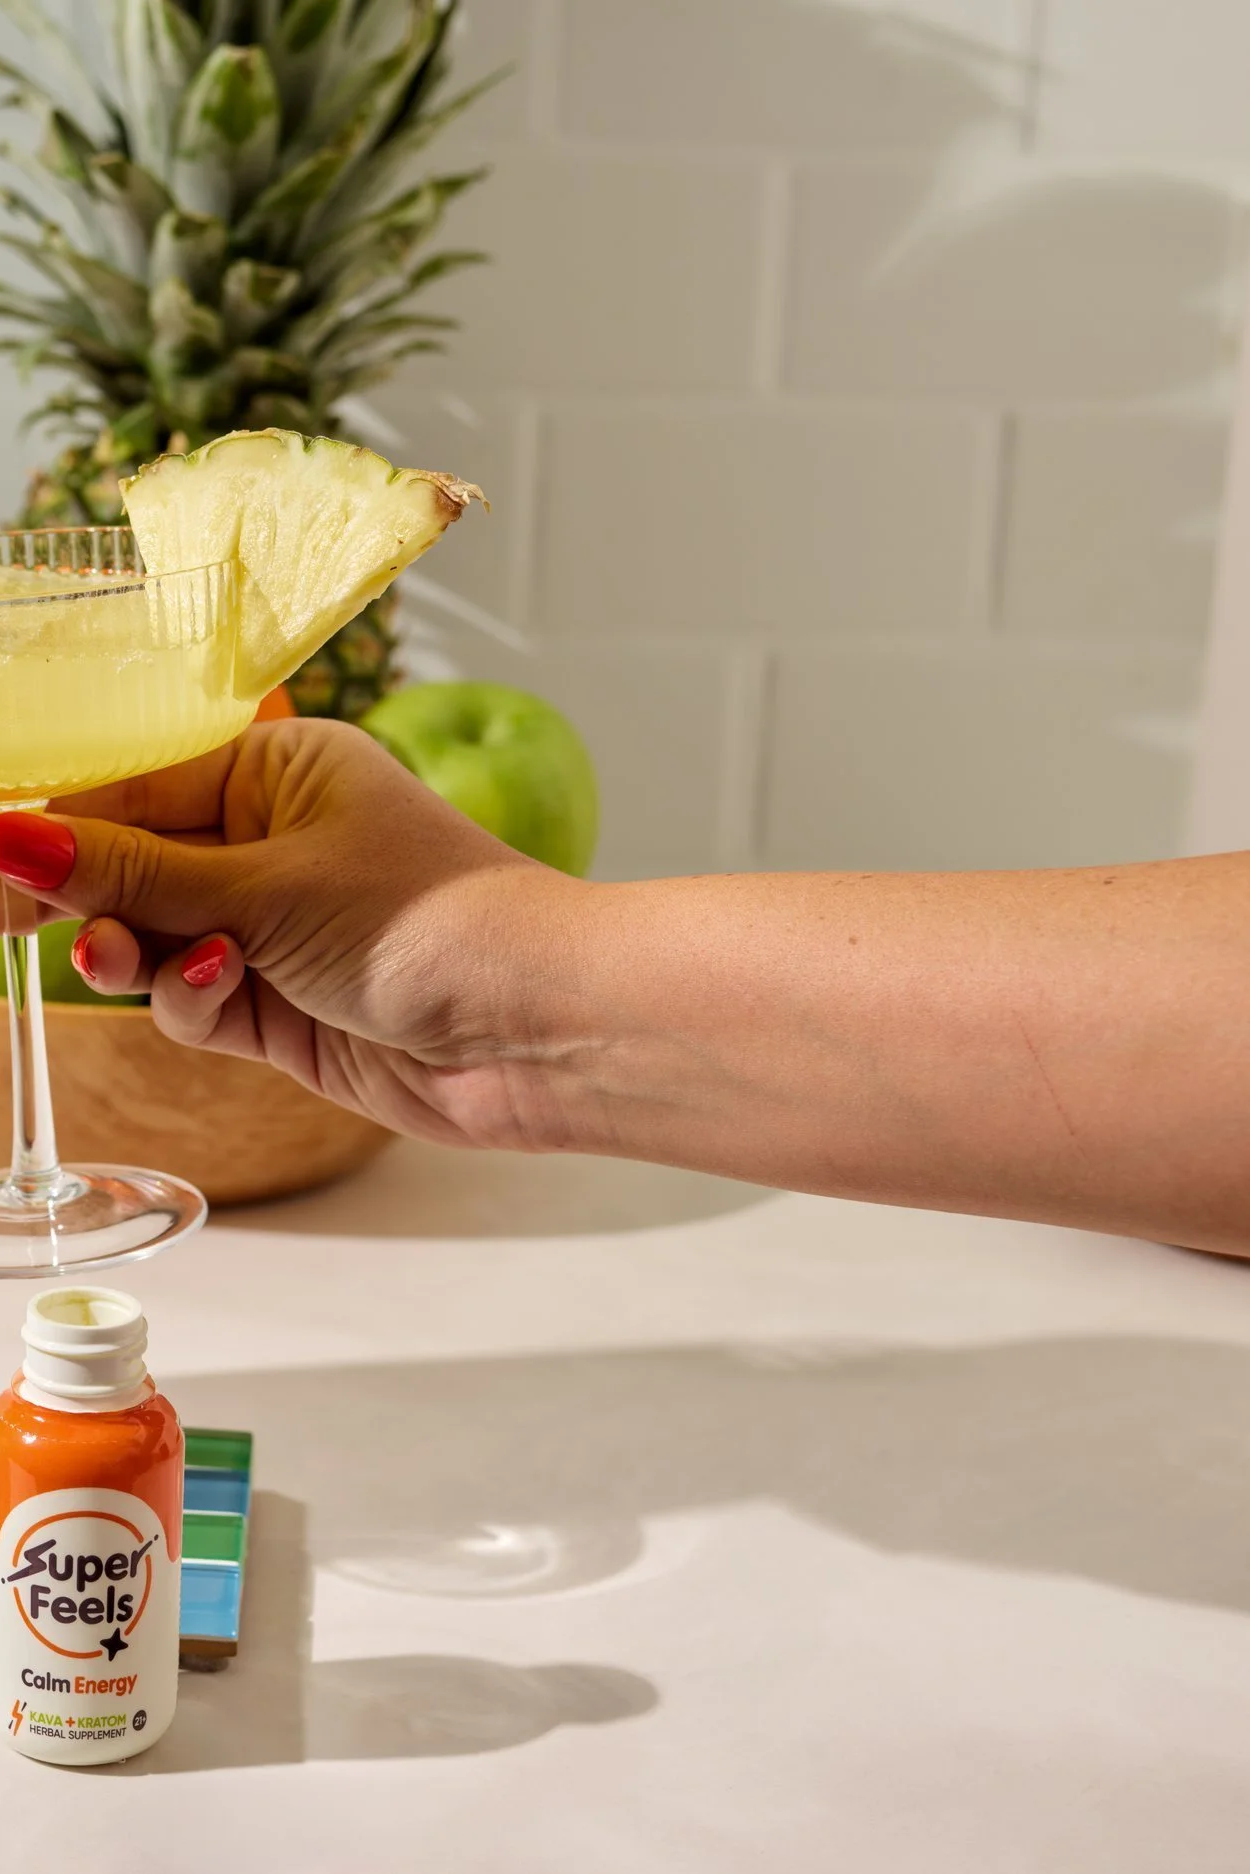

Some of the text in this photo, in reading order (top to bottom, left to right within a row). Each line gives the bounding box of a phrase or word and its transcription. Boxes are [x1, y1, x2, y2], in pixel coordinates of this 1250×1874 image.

[6, 1538, 154, 1593] Super
[30, 1584, 134, 1625] Feels
[21, 1668, 138, 1696] Calm Energy
[29, 1724, 127, 1740] HERBAL SUPPLEMENT
[30, 1710, 63, 1727] KAVA
[77, 1713, 127, 1728] KRATOM
